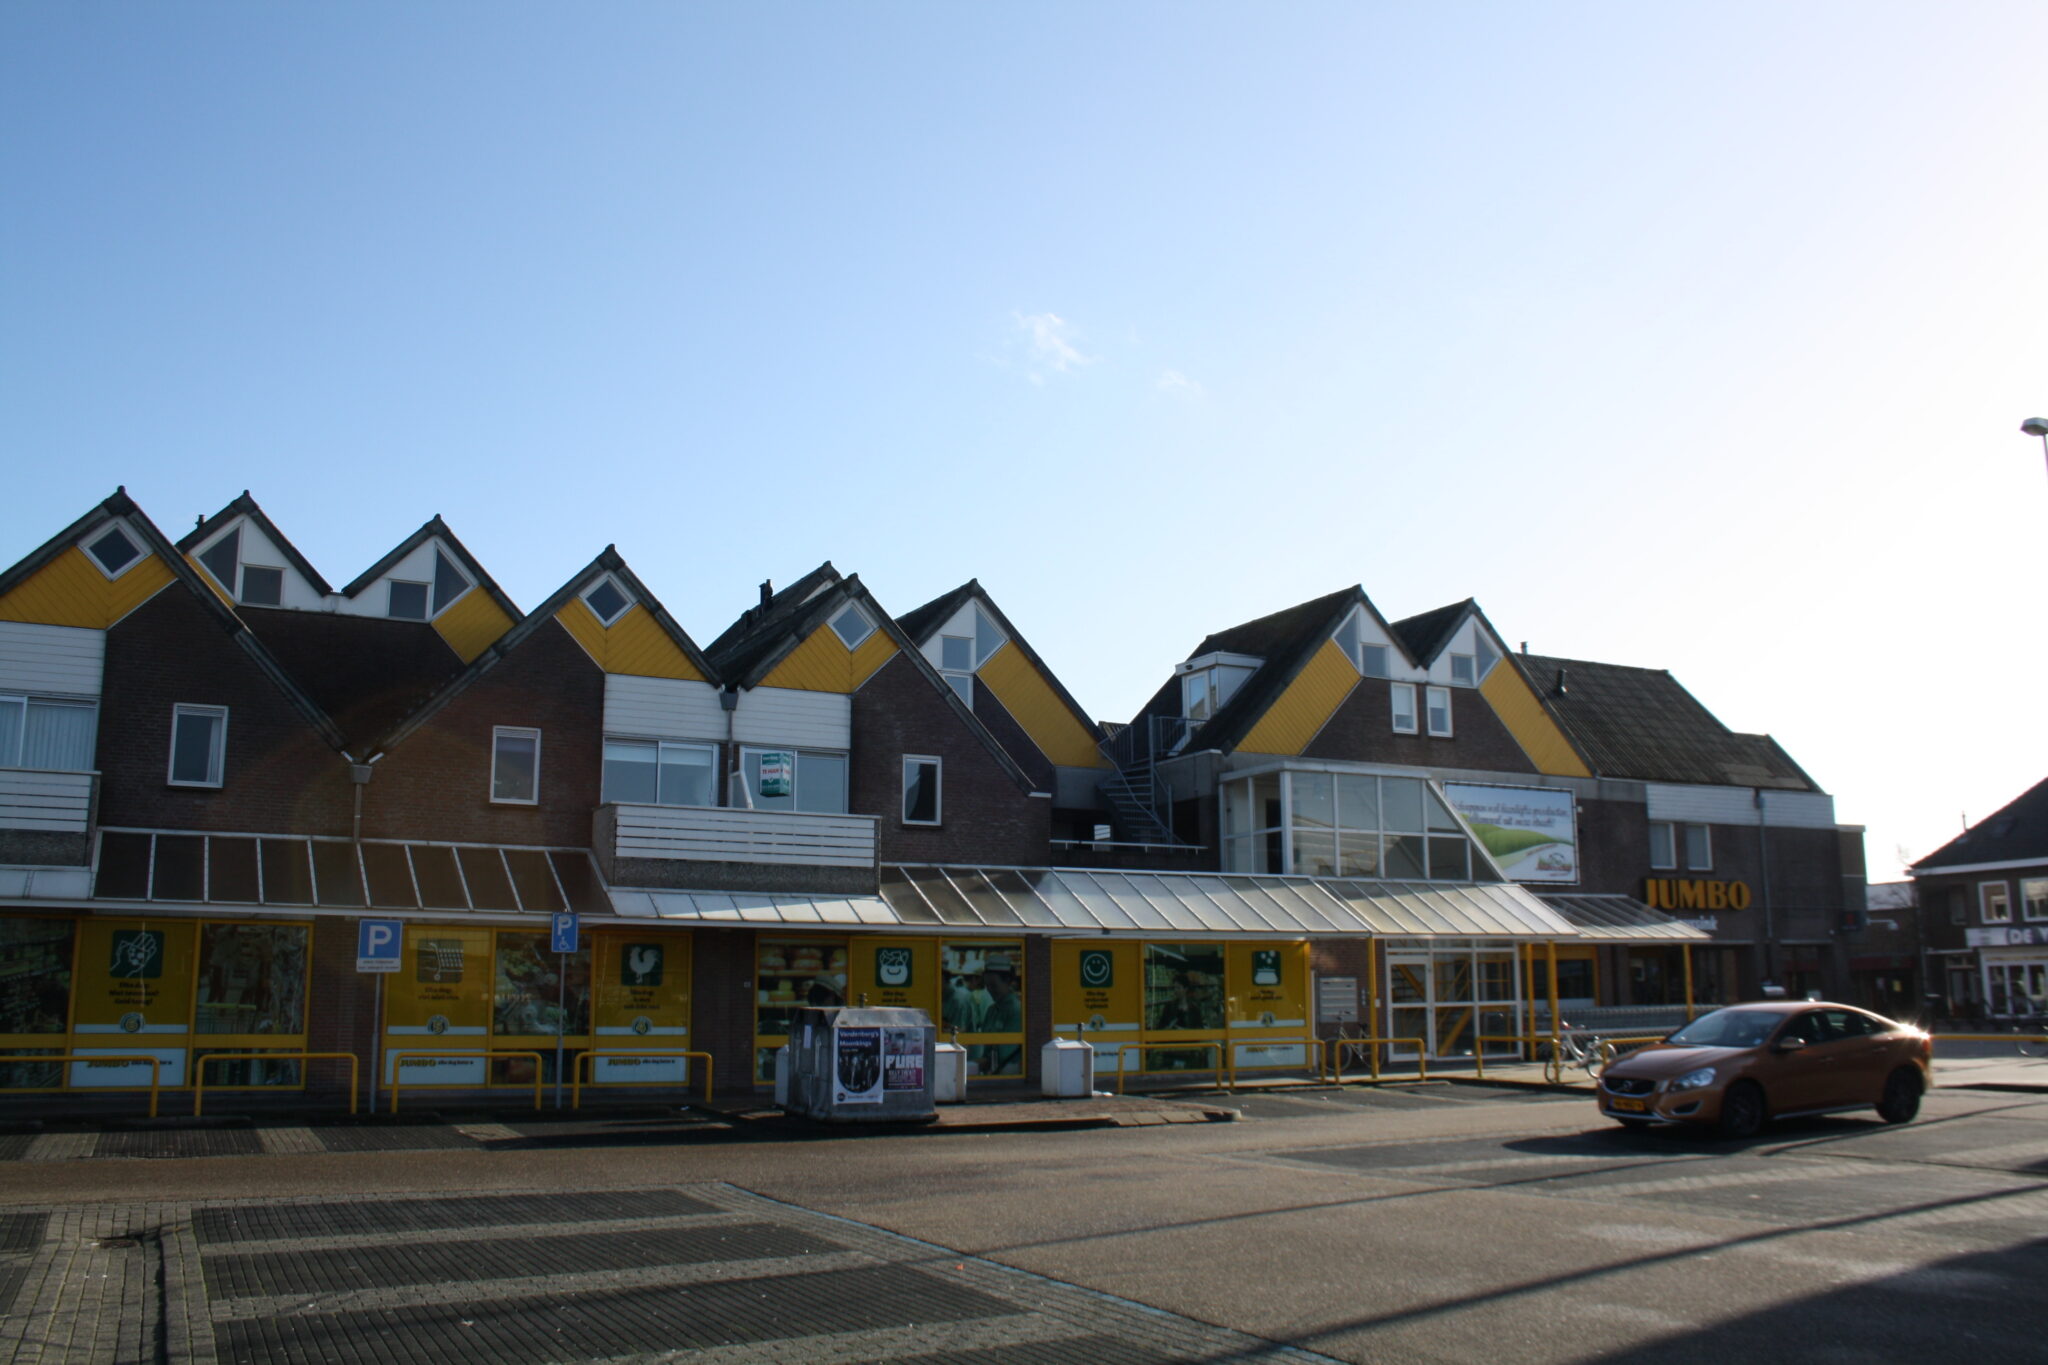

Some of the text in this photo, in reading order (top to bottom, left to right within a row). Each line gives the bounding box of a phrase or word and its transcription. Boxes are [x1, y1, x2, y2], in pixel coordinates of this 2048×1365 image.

[1645, 878, 1751, 911] JUMBO
[557, 916, 572, 937] P
[2010, 928, 2033, 945] DE
[368, 925, 392, 956] P
[886, 1054, 923, 1070] PURE
